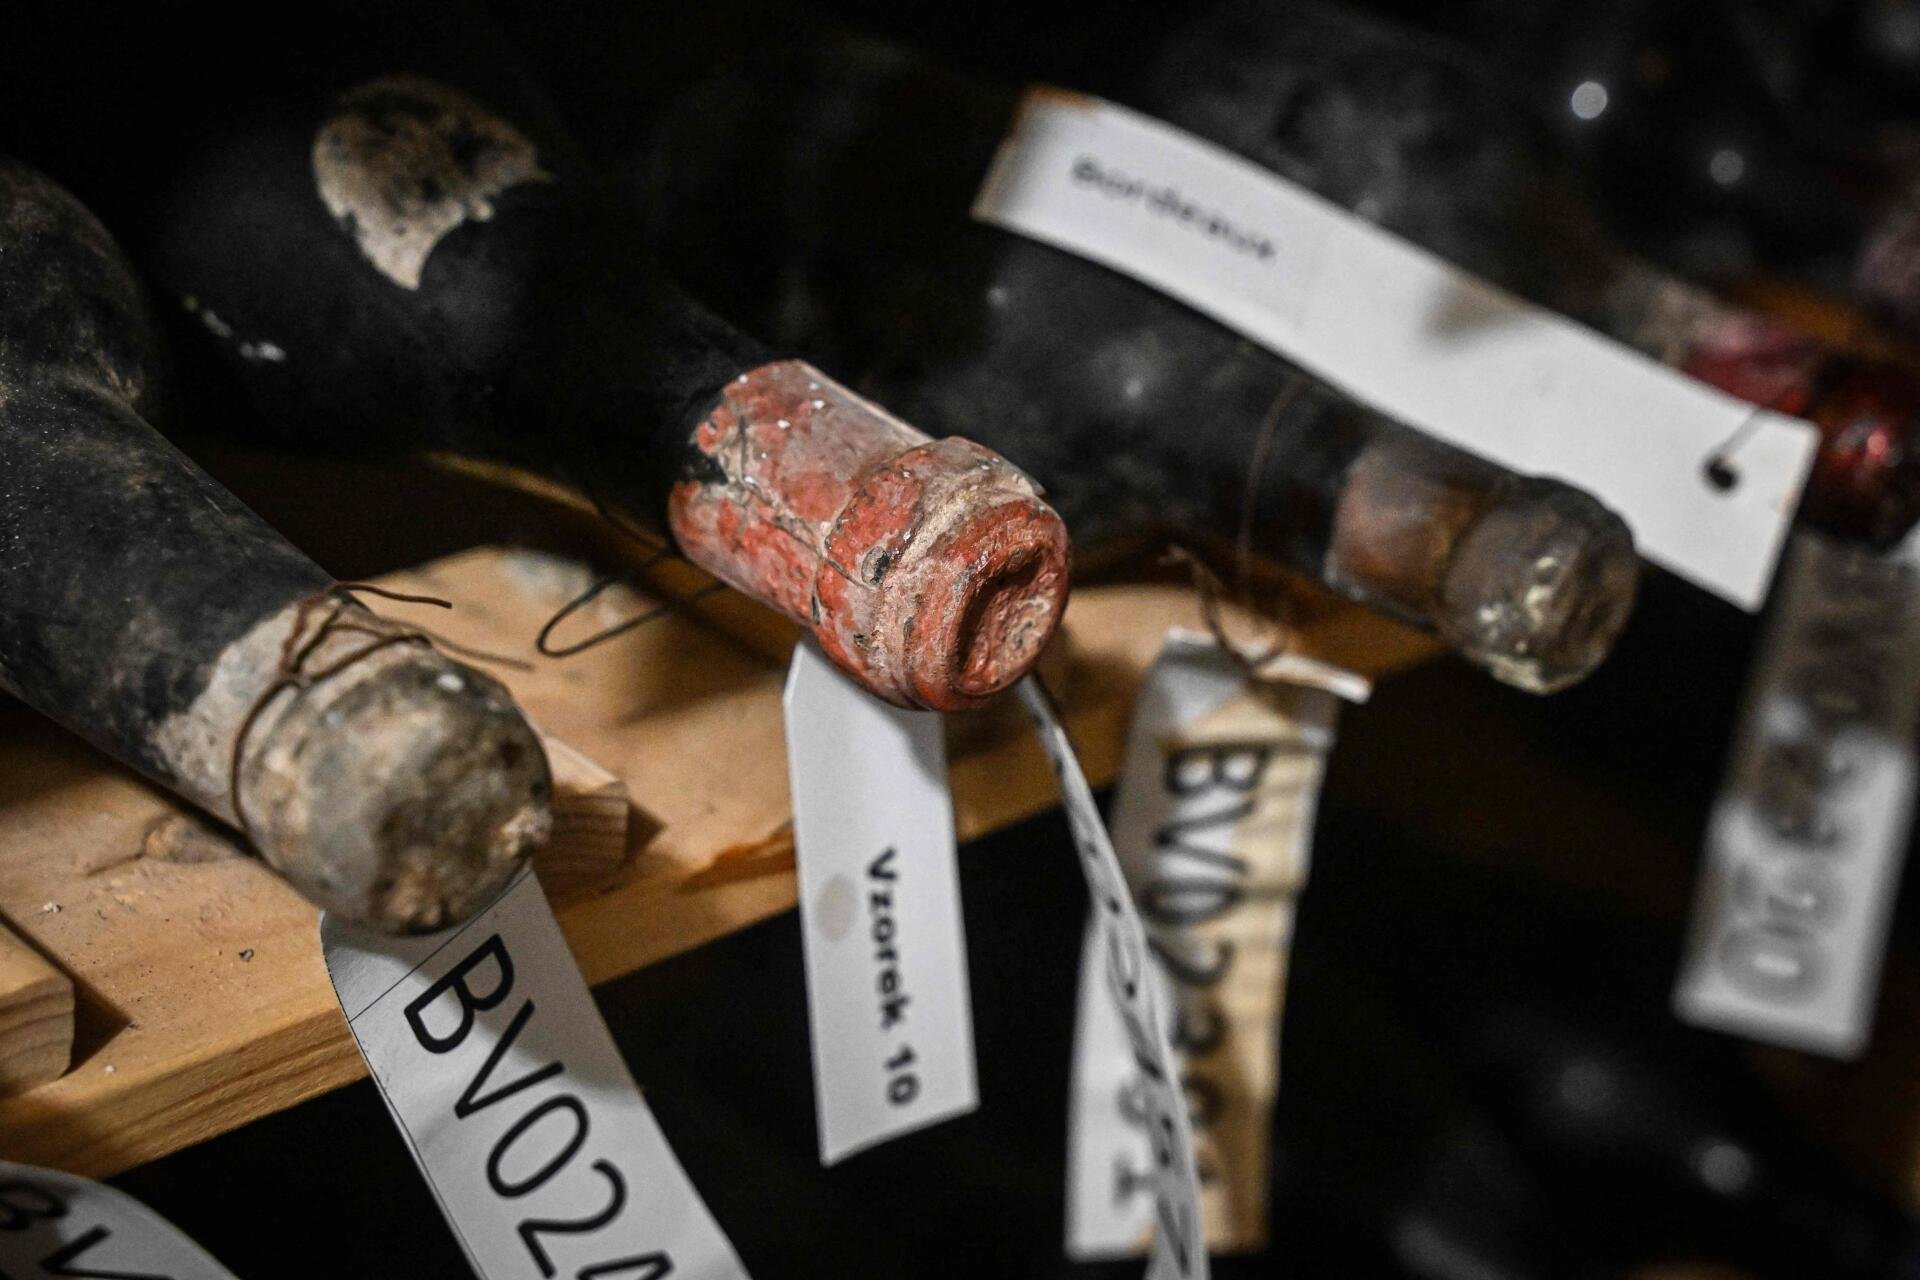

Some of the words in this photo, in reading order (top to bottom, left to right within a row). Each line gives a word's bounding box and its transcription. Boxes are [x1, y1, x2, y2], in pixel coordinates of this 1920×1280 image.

[1070, 152, 1277, 264] Bordeaux
[866, 845, 910, 1031] Vzorek
[884, 1045, 921, 1107] 10
